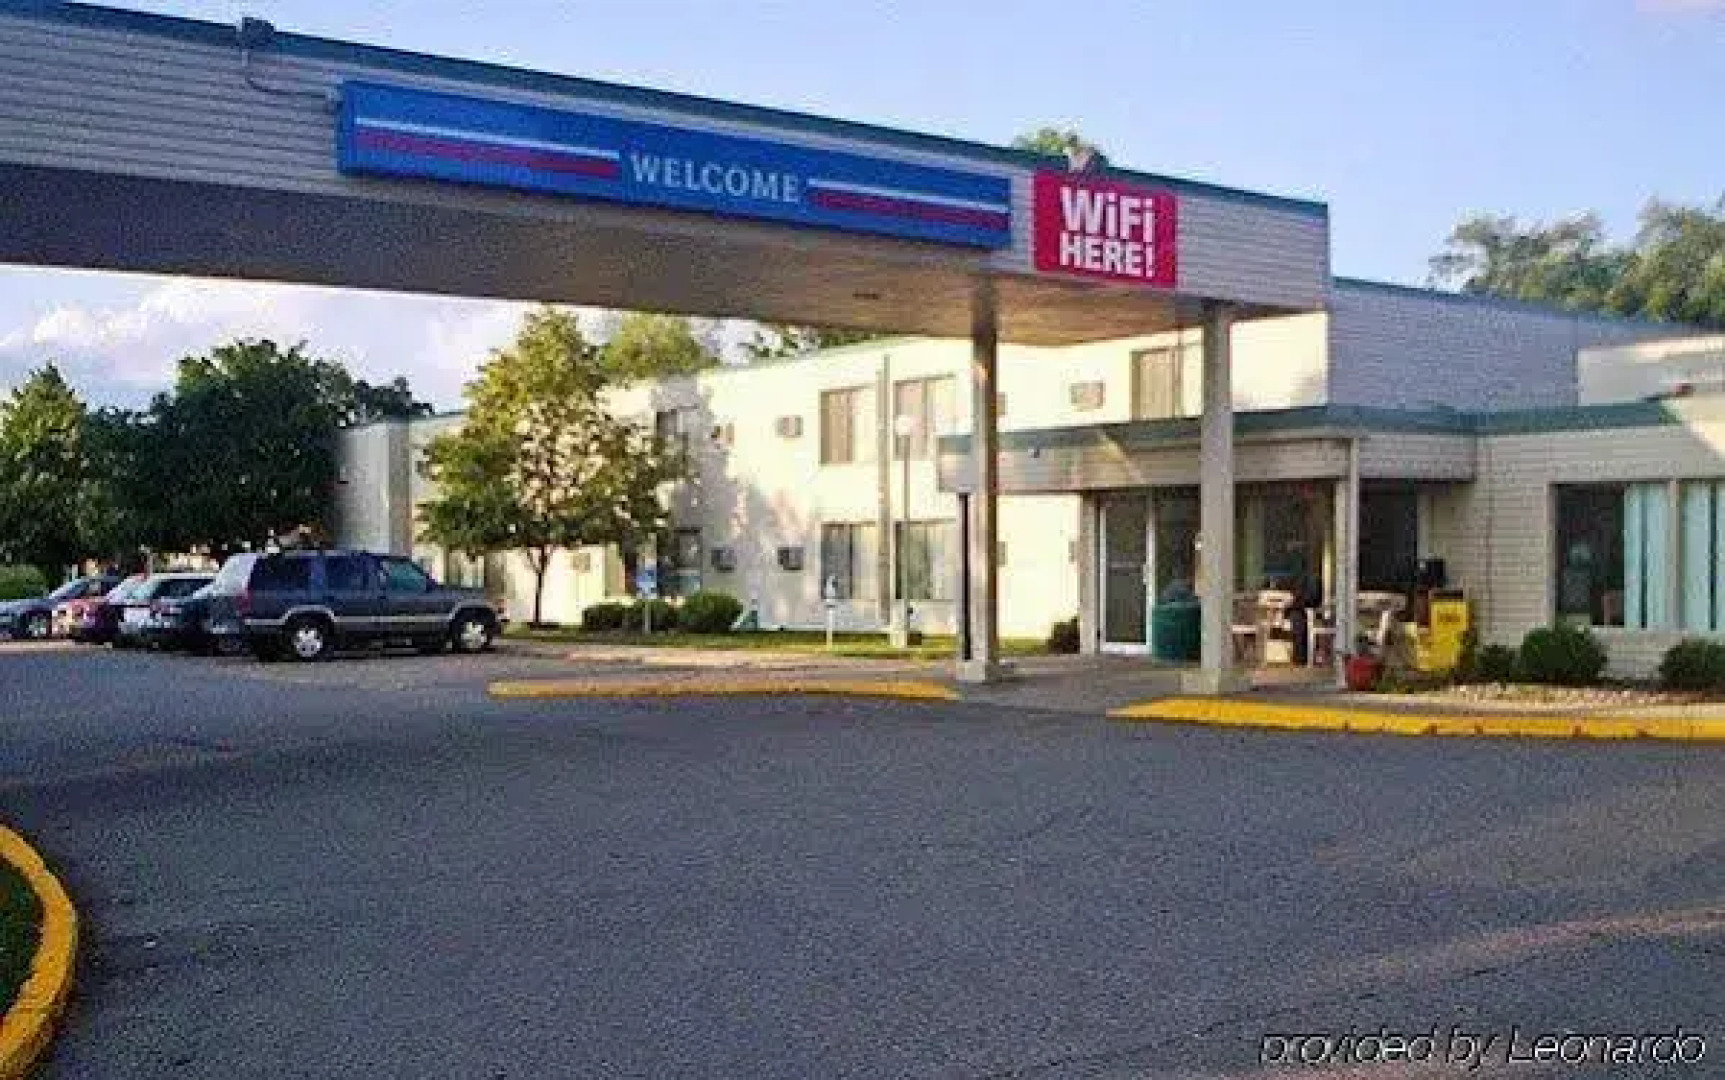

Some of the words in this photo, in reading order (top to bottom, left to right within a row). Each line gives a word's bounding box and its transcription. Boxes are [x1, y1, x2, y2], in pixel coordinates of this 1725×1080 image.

[630, 153, 799, 203] WELCOME
[1061, 186, 1155, 243] WiFi
[1060, 231, 1154, 278] HERE!
